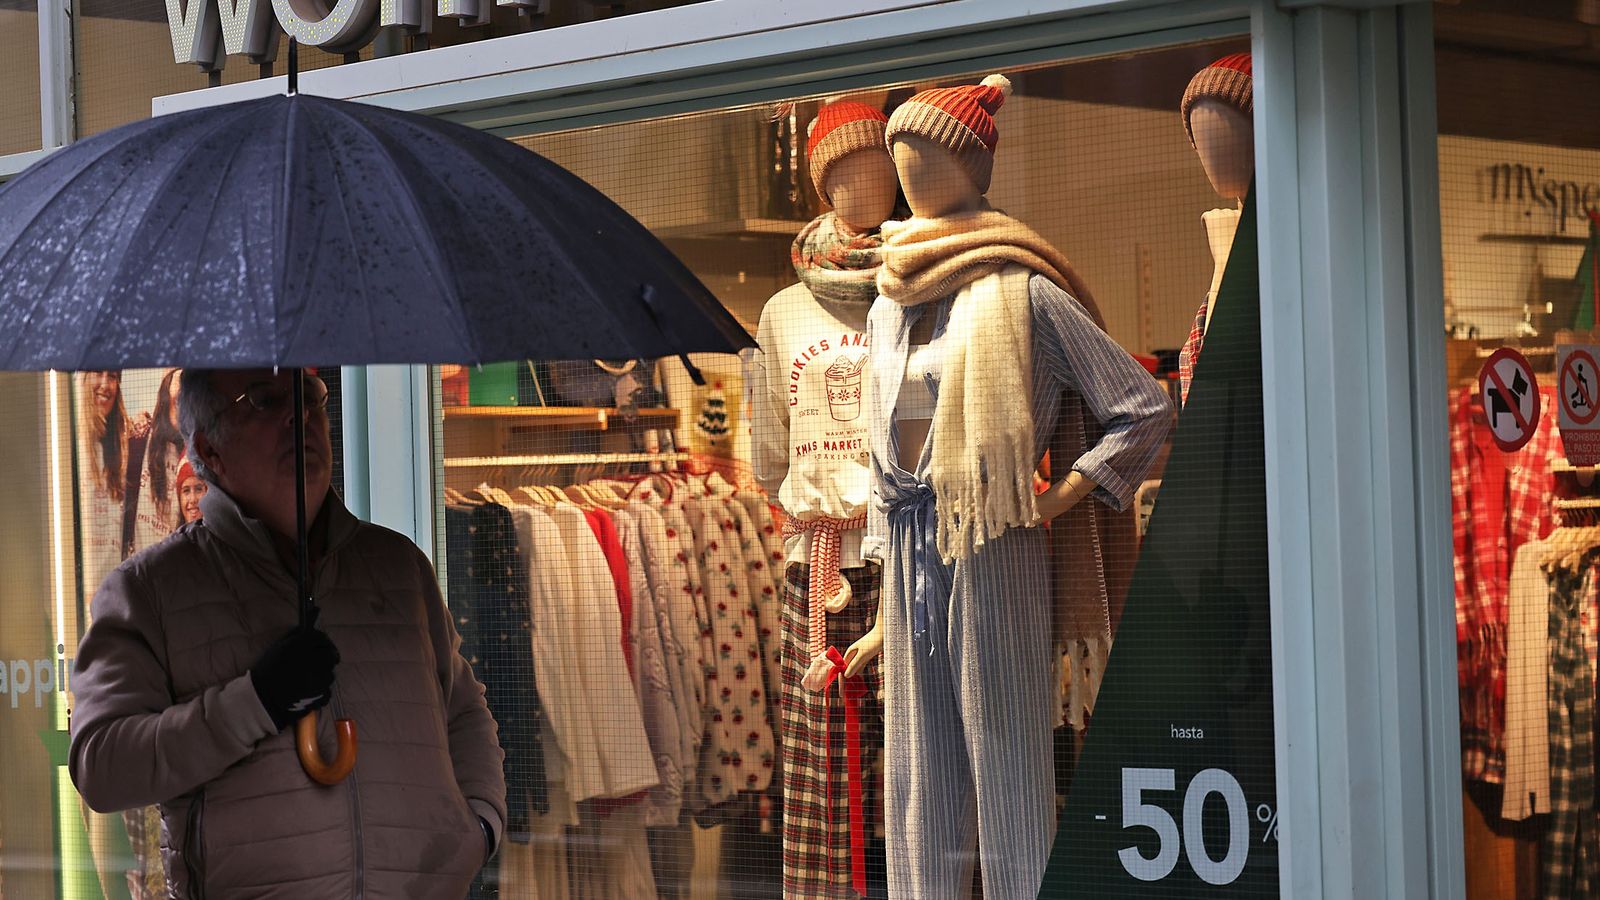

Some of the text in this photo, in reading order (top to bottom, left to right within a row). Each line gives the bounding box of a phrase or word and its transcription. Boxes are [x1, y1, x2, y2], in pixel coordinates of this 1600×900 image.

[789, 339, 830, 406] COOKIES
[795, 441, 818, 457] XMAS
[823, 438, 862, 451] MARKET
[1171, 724, 1204, 739] hasta
